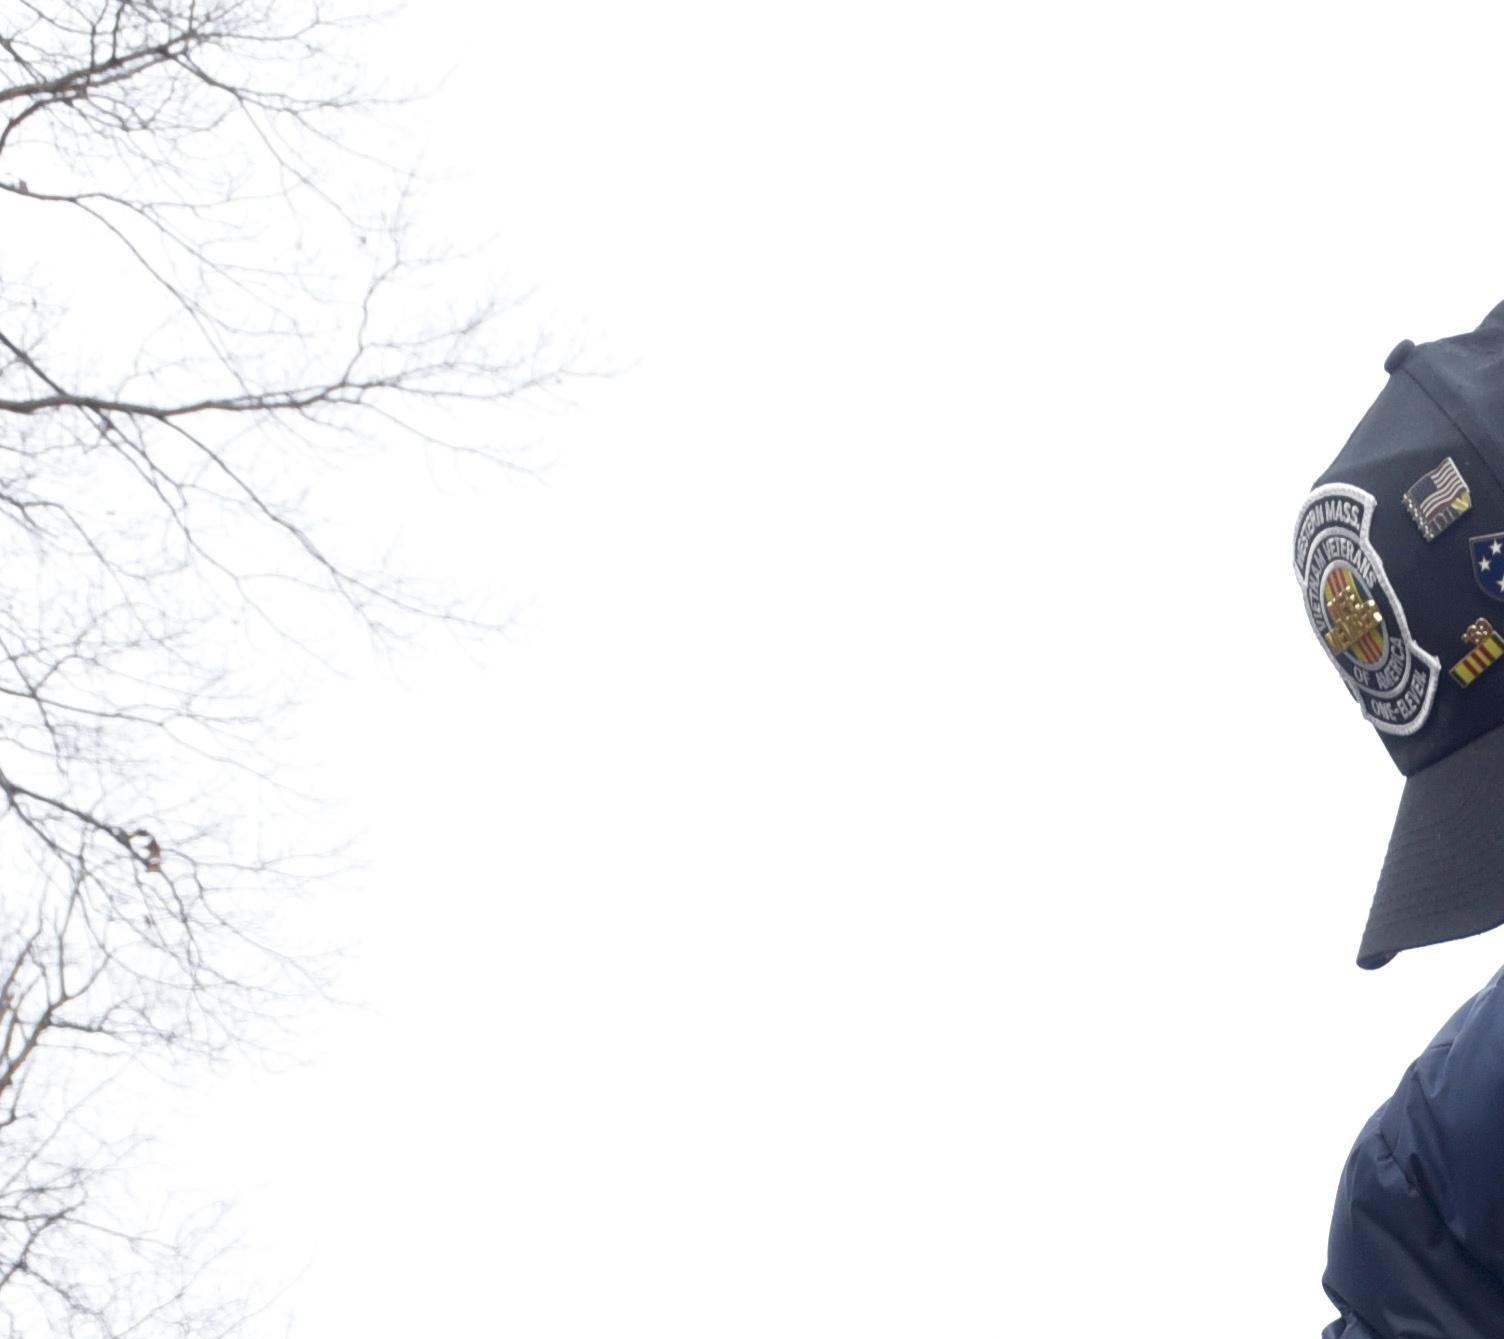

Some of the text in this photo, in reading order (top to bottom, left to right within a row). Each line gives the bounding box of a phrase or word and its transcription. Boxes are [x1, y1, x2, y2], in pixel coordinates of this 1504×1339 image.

[1297, 503, 1324, 569] WESTERN
[1308, 551, 1327, 632] VIETNAM
[1323, 537, 1378, 589] VETERANS
[1353, 637, 1404, 690] OF AMERICA
